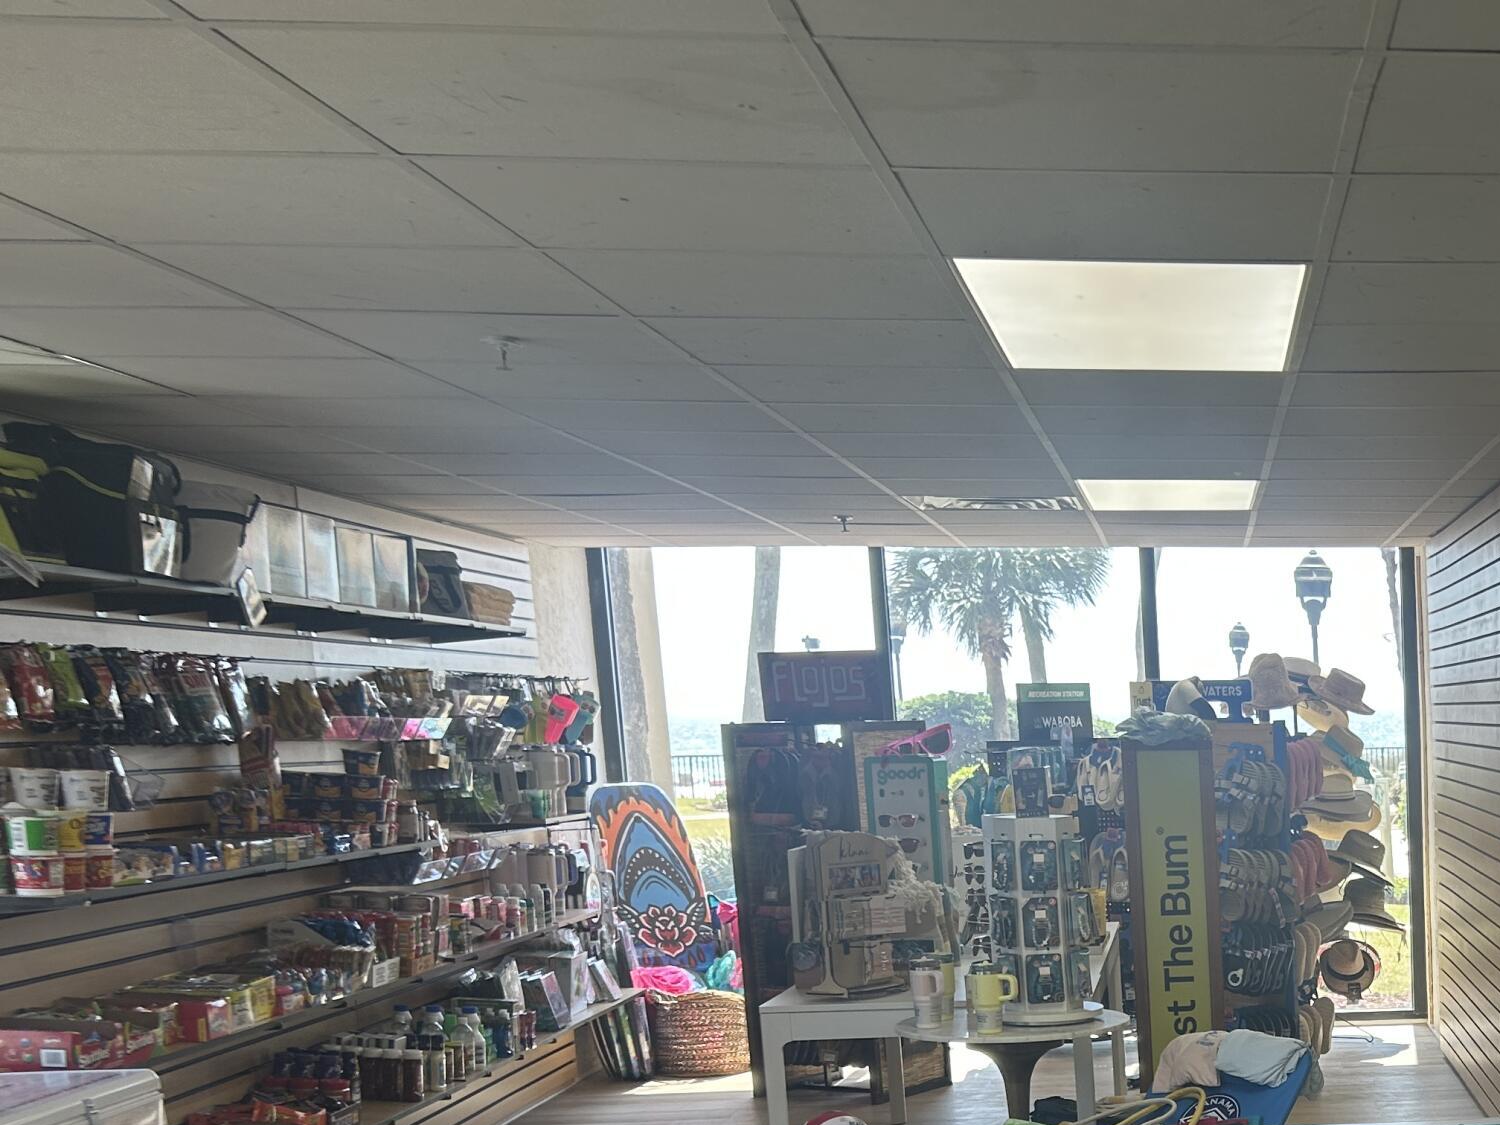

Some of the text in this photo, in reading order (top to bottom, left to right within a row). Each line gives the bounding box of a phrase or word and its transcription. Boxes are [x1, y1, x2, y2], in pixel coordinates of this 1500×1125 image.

[1028, 690, 1061, 698] RECREATION
[1041, 715, 1083, 728] WABOBA
[877, 766, 925, 784] goodr
[1163, 925, 1195, 992] The
